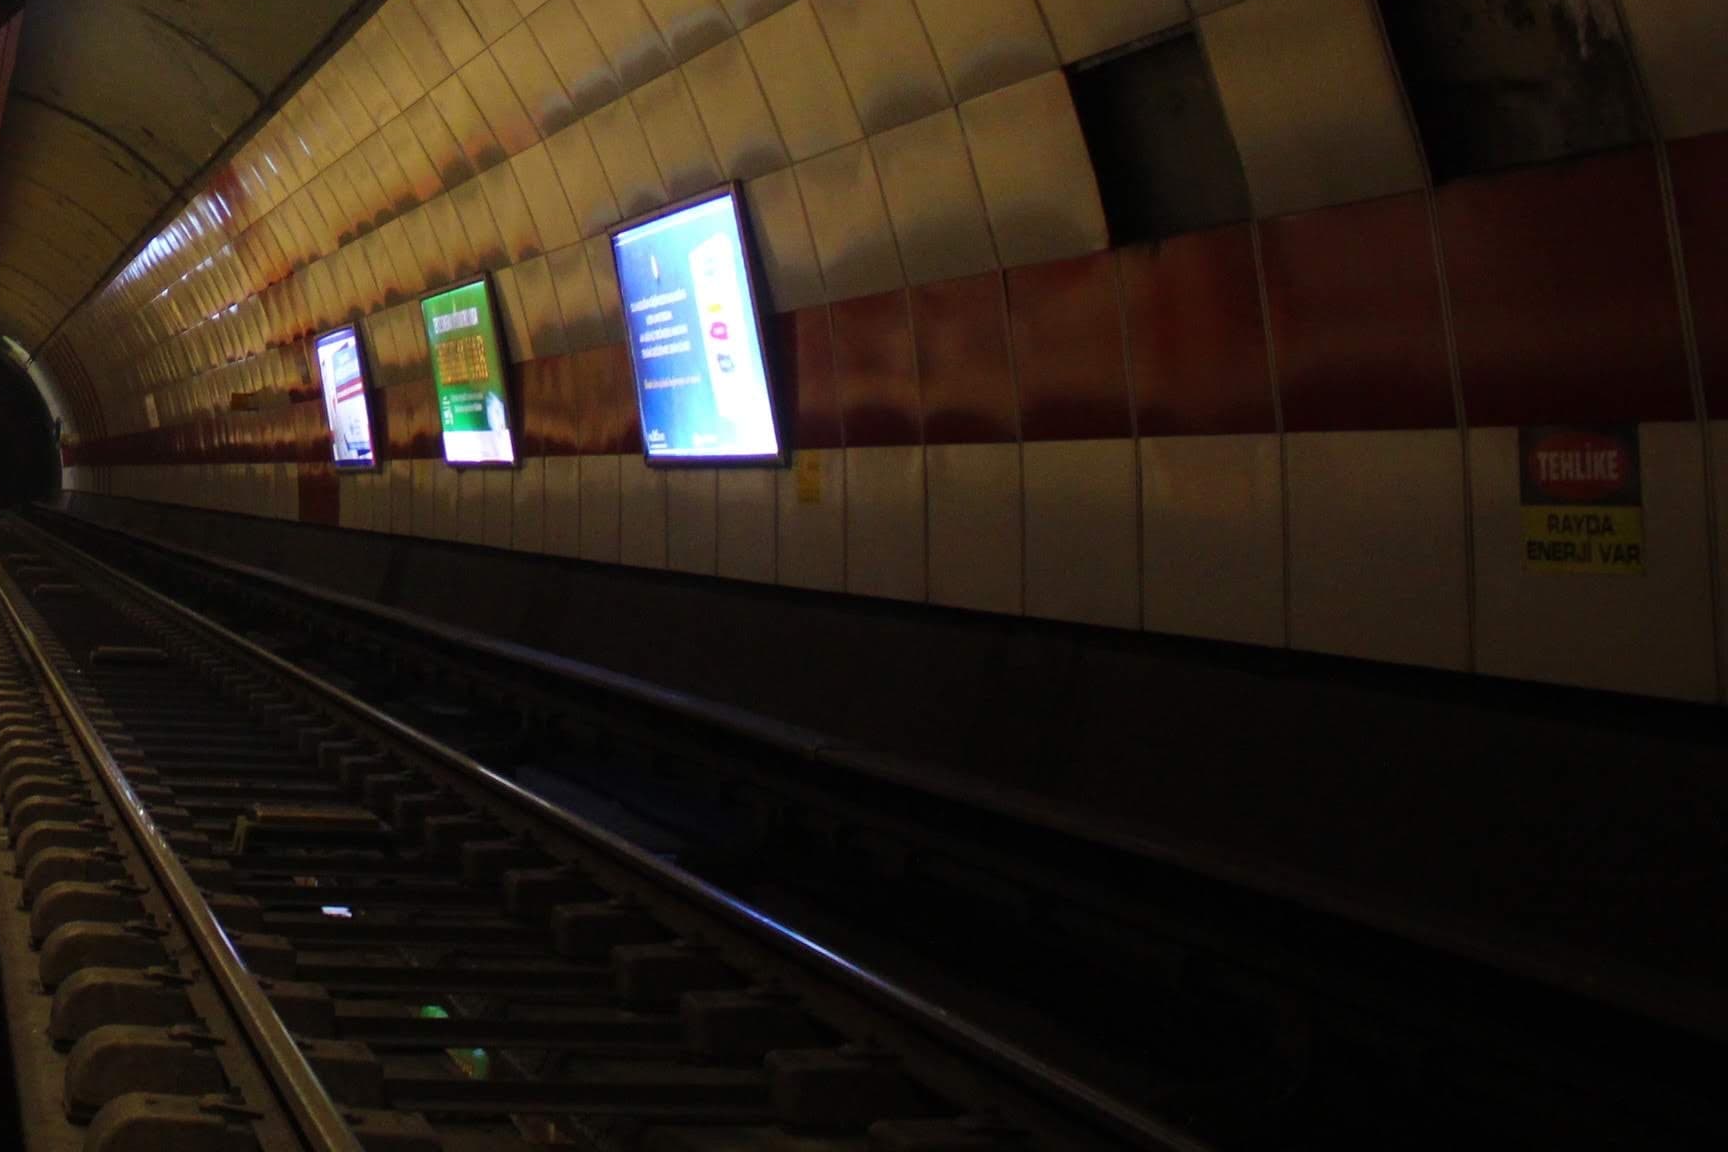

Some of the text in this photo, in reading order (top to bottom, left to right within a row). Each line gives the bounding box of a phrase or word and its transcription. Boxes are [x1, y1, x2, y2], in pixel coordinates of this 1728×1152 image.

[1536, 442, 1619, 481] TEHLİKE
[1547, 512, 1616, 536] RAYDA
[1599, 542, 1642, 565] VAR
